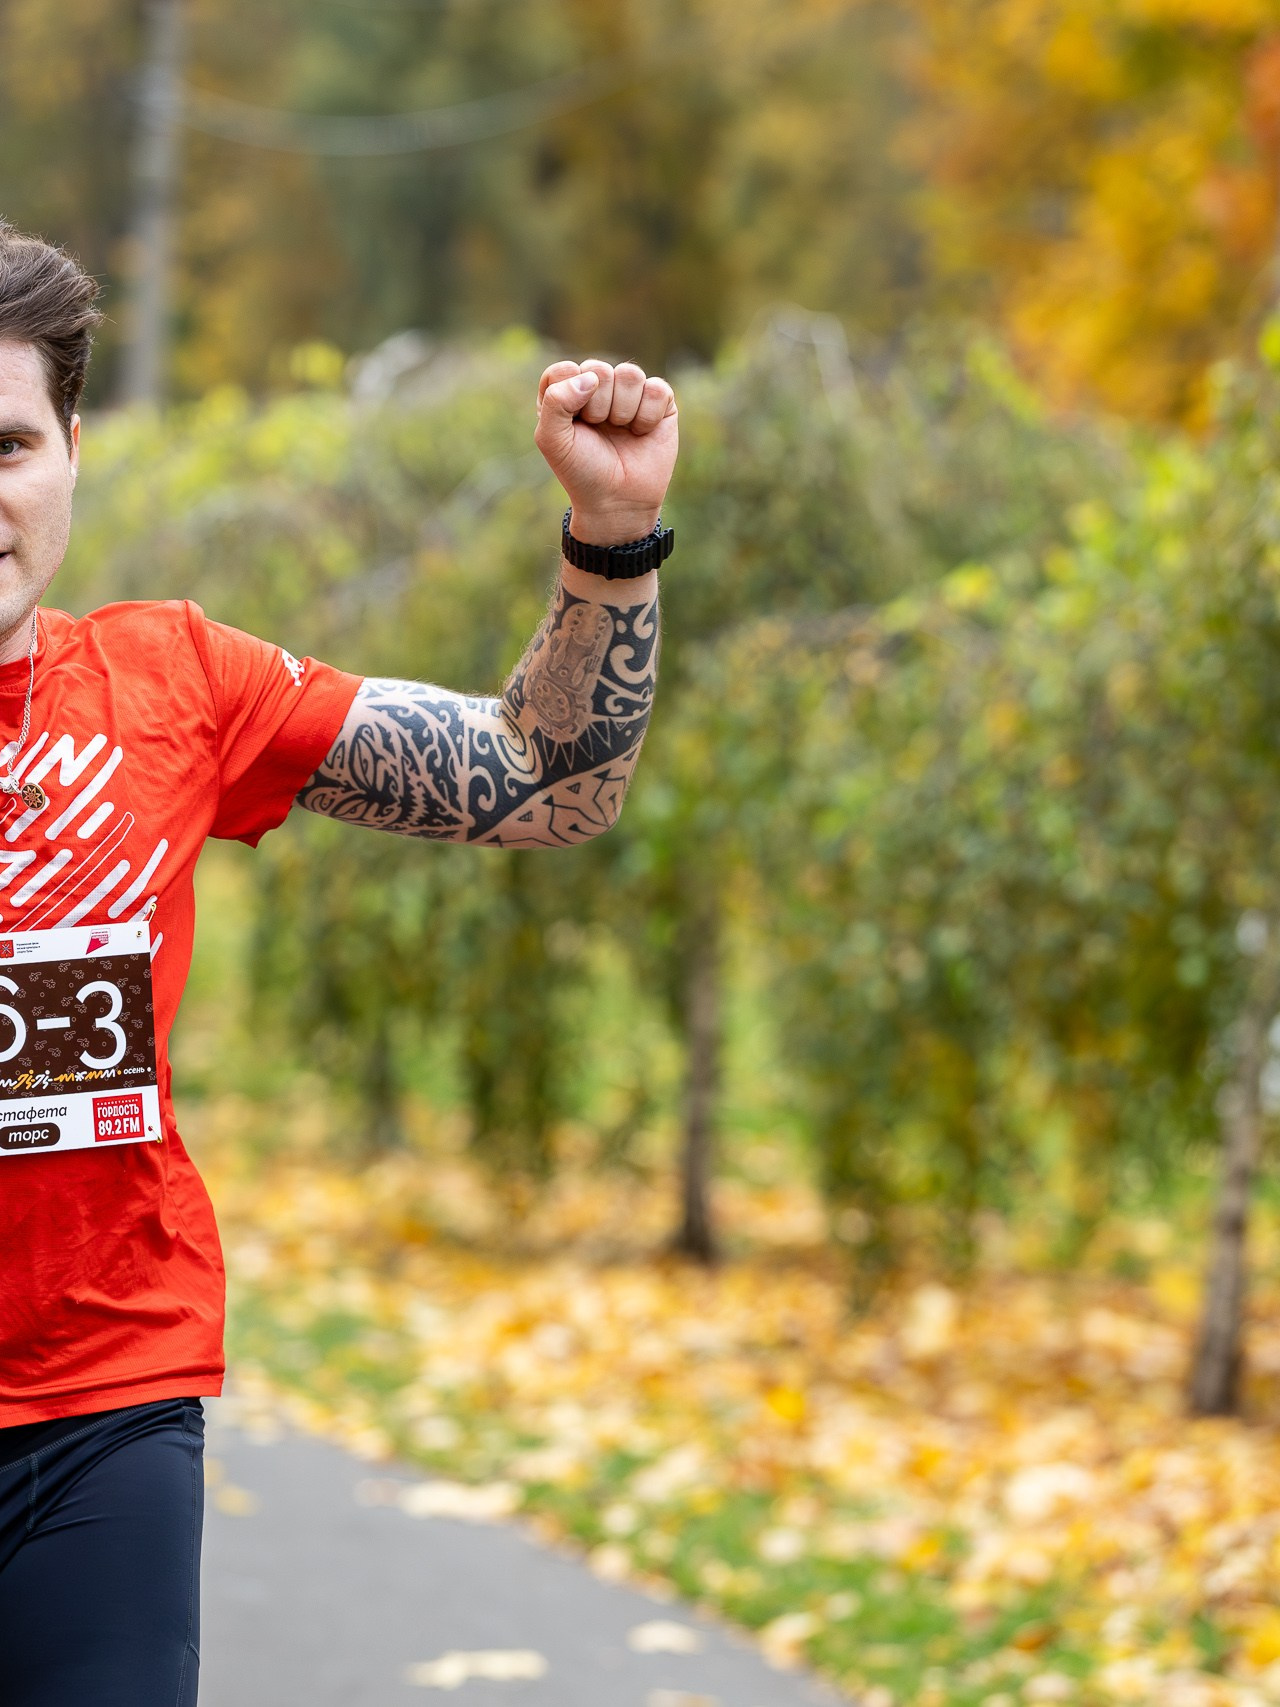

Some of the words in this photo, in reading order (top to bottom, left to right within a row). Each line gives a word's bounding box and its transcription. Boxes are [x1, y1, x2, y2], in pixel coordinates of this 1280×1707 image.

[123, 1066, 146, 1075] осень
[97, 1103, 140, 1119] ГОРДОСТЬ
[97, 1118, 122, 1137] 89.2
[122, 1116, 141, 1134] FM
[8, 1127, 50, 1144] торс
